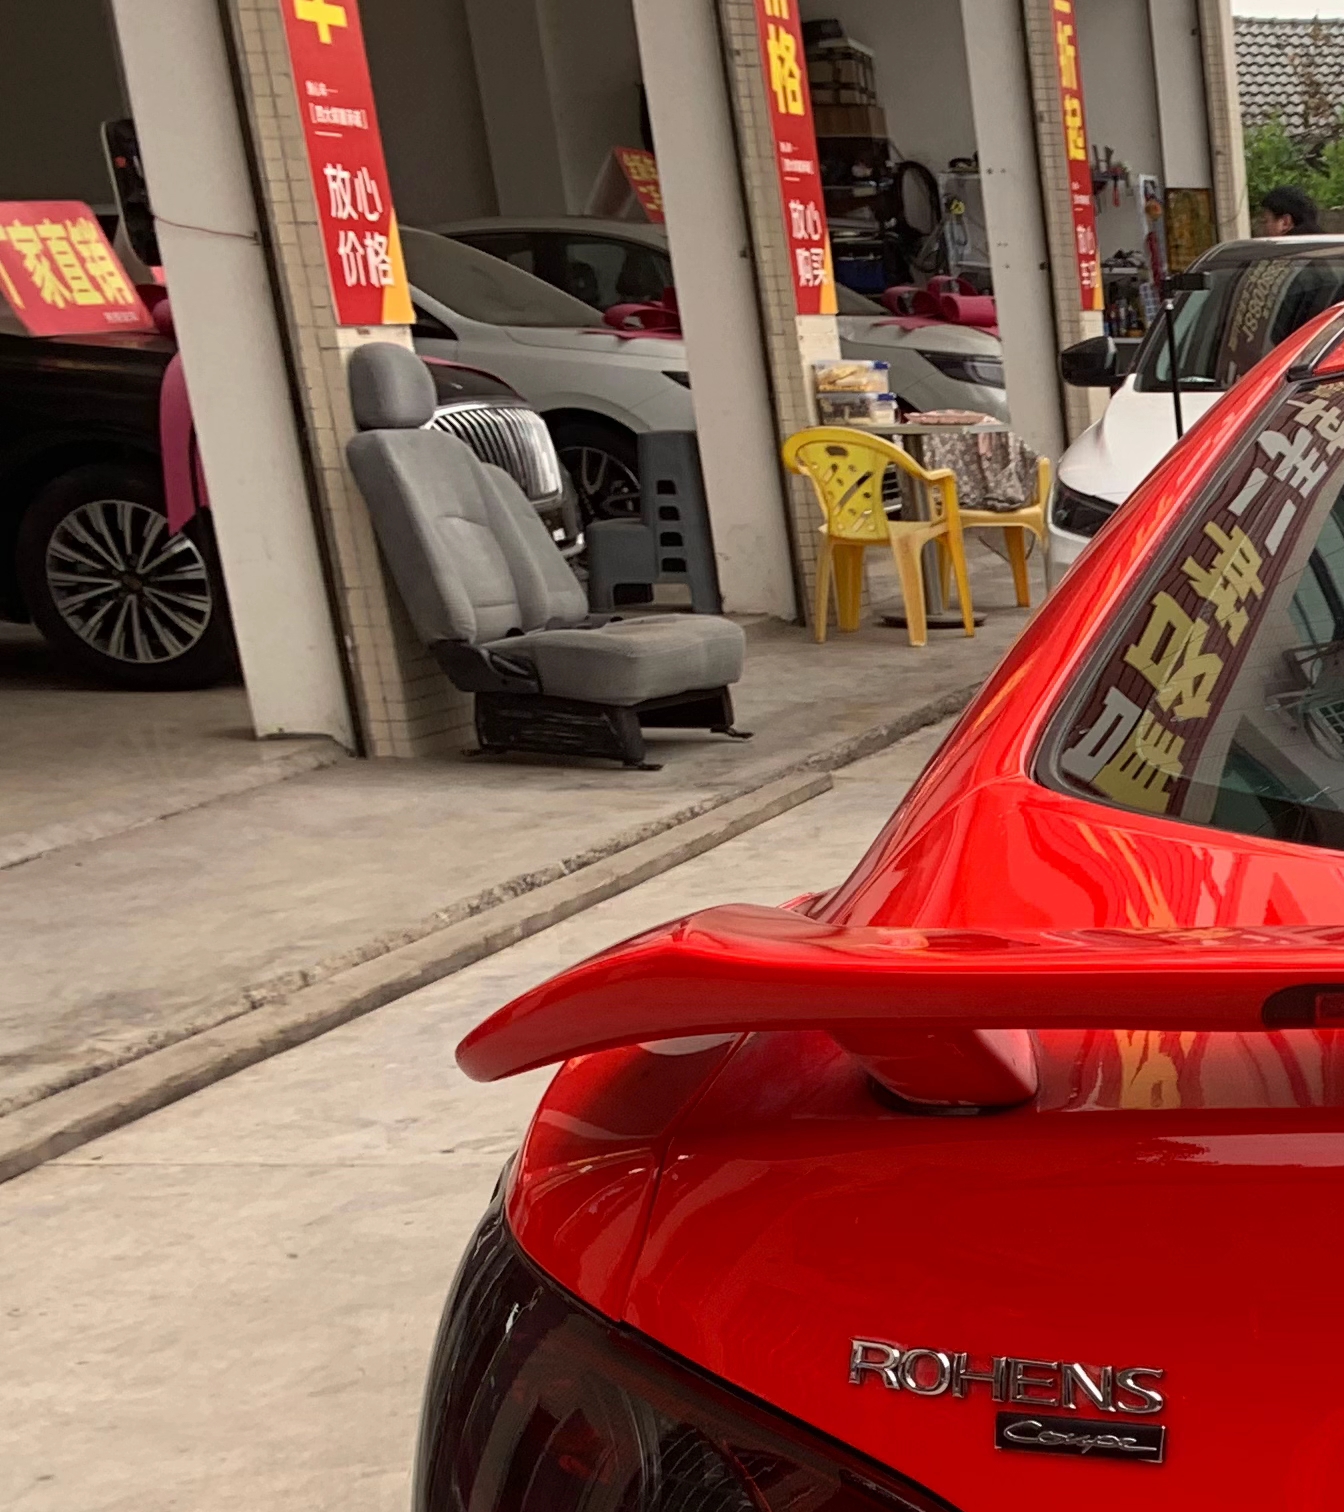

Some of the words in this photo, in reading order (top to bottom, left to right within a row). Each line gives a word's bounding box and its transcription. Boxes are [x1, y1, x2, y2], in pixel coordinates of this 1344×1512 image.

[763, 0, 805, 116] 格
[323, 163, 383, 222] 放心
[788, 199, 823, 241] 放心
[338, 230, 395, 288] 价格
[795, 247, 828, 287] 购买
[848, 1335, 1164, 1413] ROHENS
[1003, 1419, 1157, 1454] Coupe
